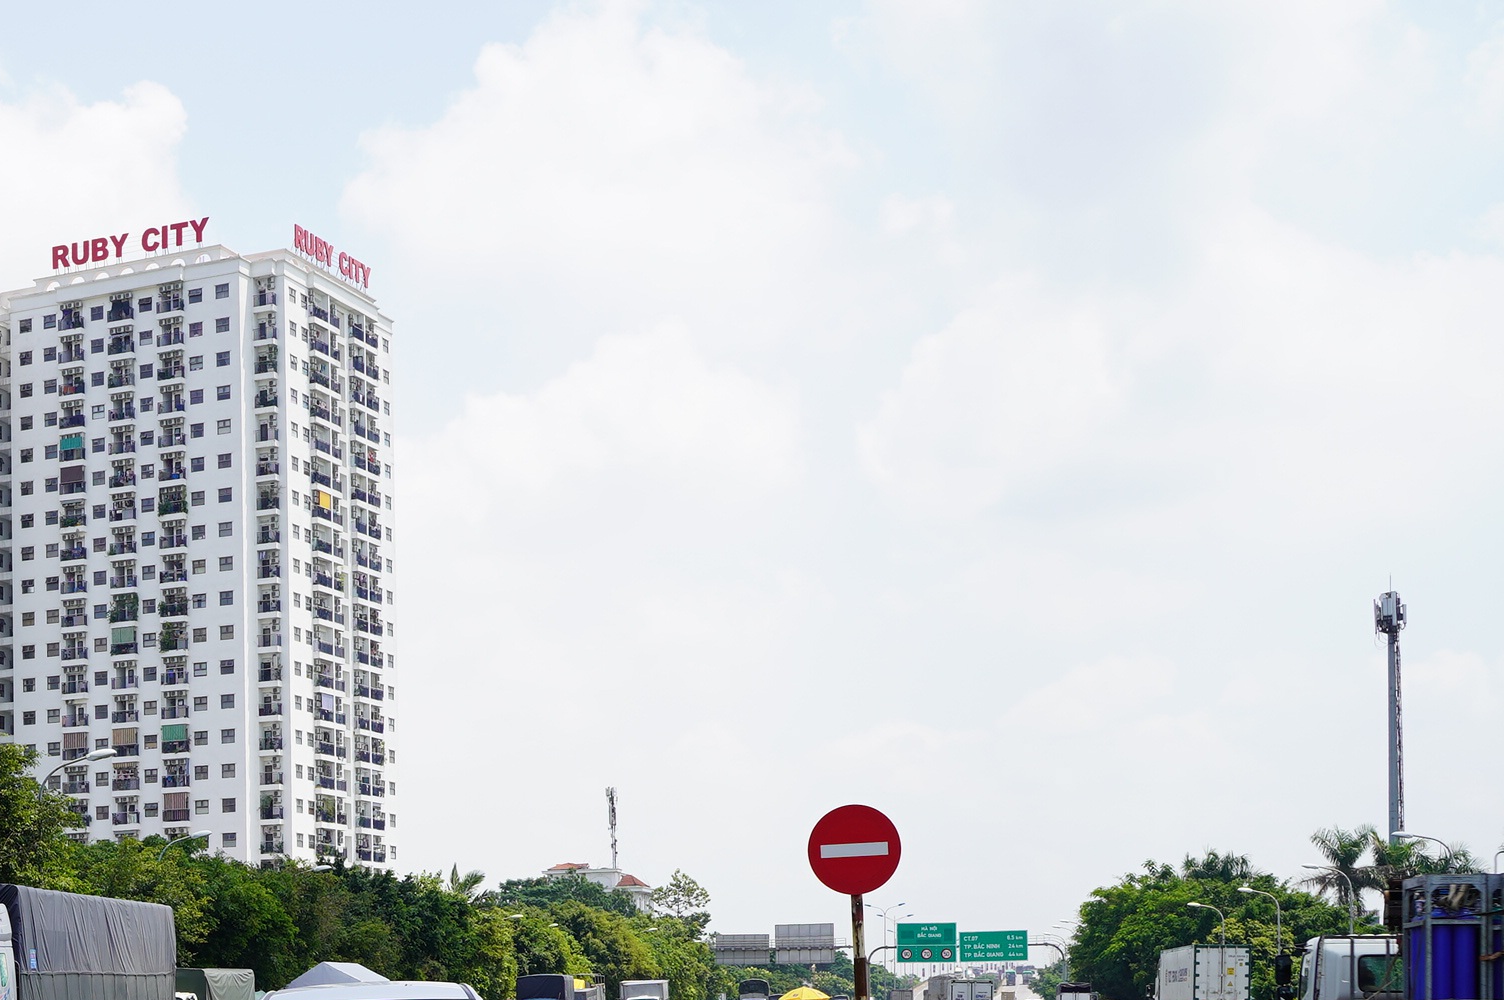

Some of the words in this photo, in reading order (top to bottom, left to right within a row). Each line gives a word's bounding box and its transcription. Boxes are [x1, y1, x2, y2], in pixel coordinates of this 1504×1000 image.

[52, 233, 129, 270] RUBY
[141, 216, 210, 252] CITY
[294, 223, 334, 265] RUBY
[338, 251, 372, 289] CITY
